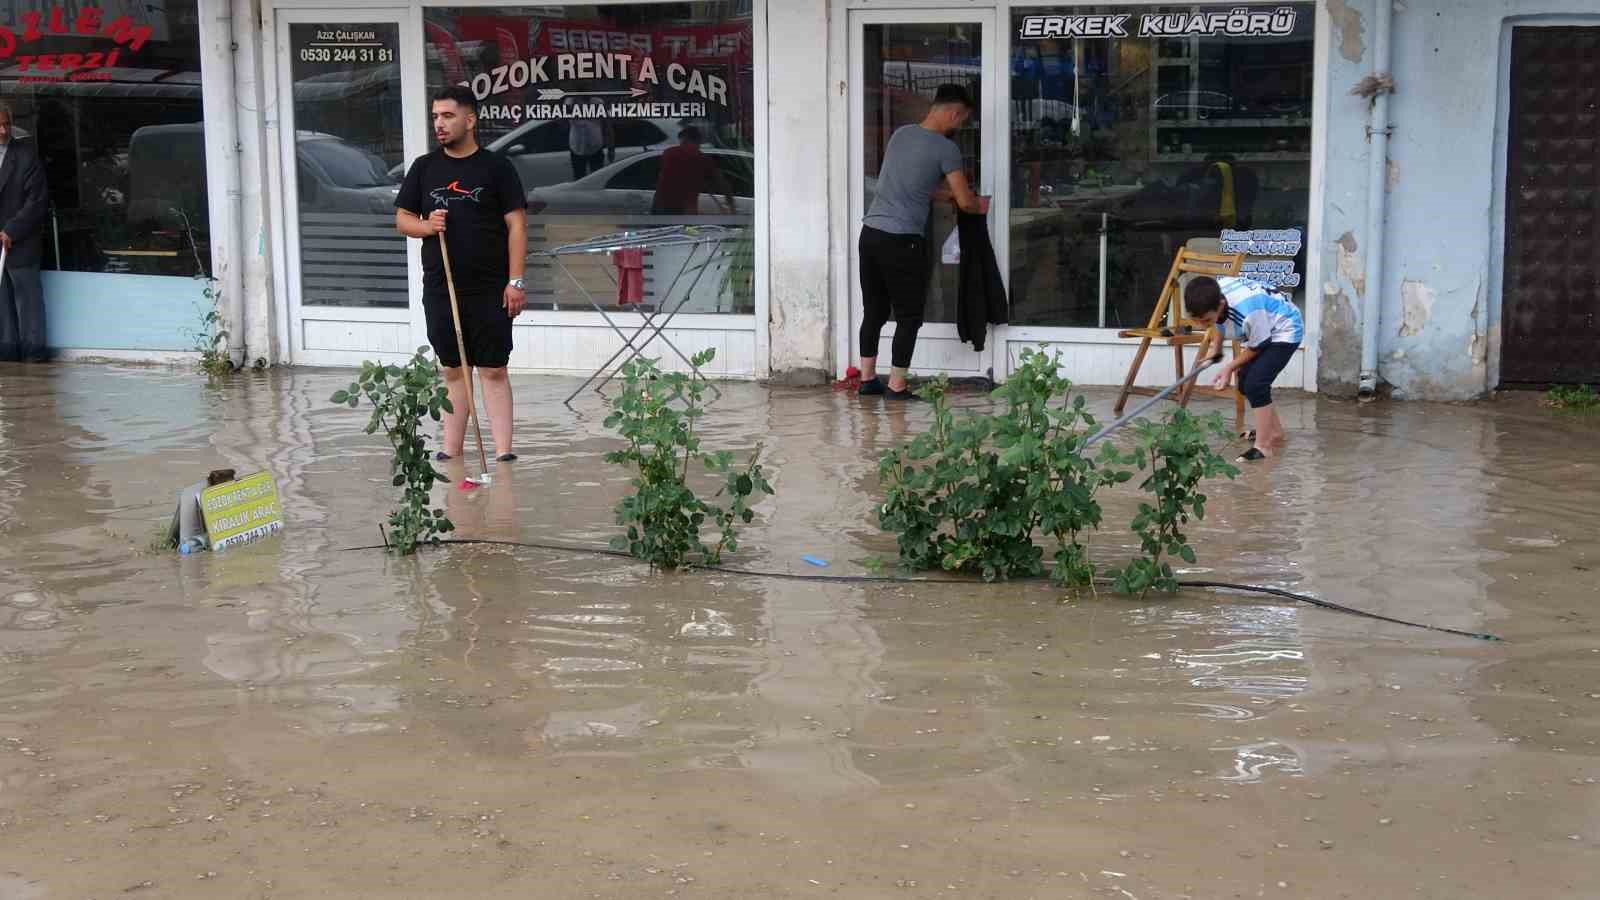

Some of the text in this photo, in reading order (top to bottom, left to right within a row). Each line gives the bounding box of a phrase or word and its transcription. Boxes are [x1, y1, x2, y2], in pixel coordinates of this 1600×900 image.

[1021, 7, 1296, 38] ERKEK KUAFÖRÜ
[300, 48, 393, 61] 0530 244 31 81
[457, 53, 728, 106] OZOK RENT A CAR
[479, 102, 706, 123] ARAÇ KİRALAMA HİZMETLERİ
